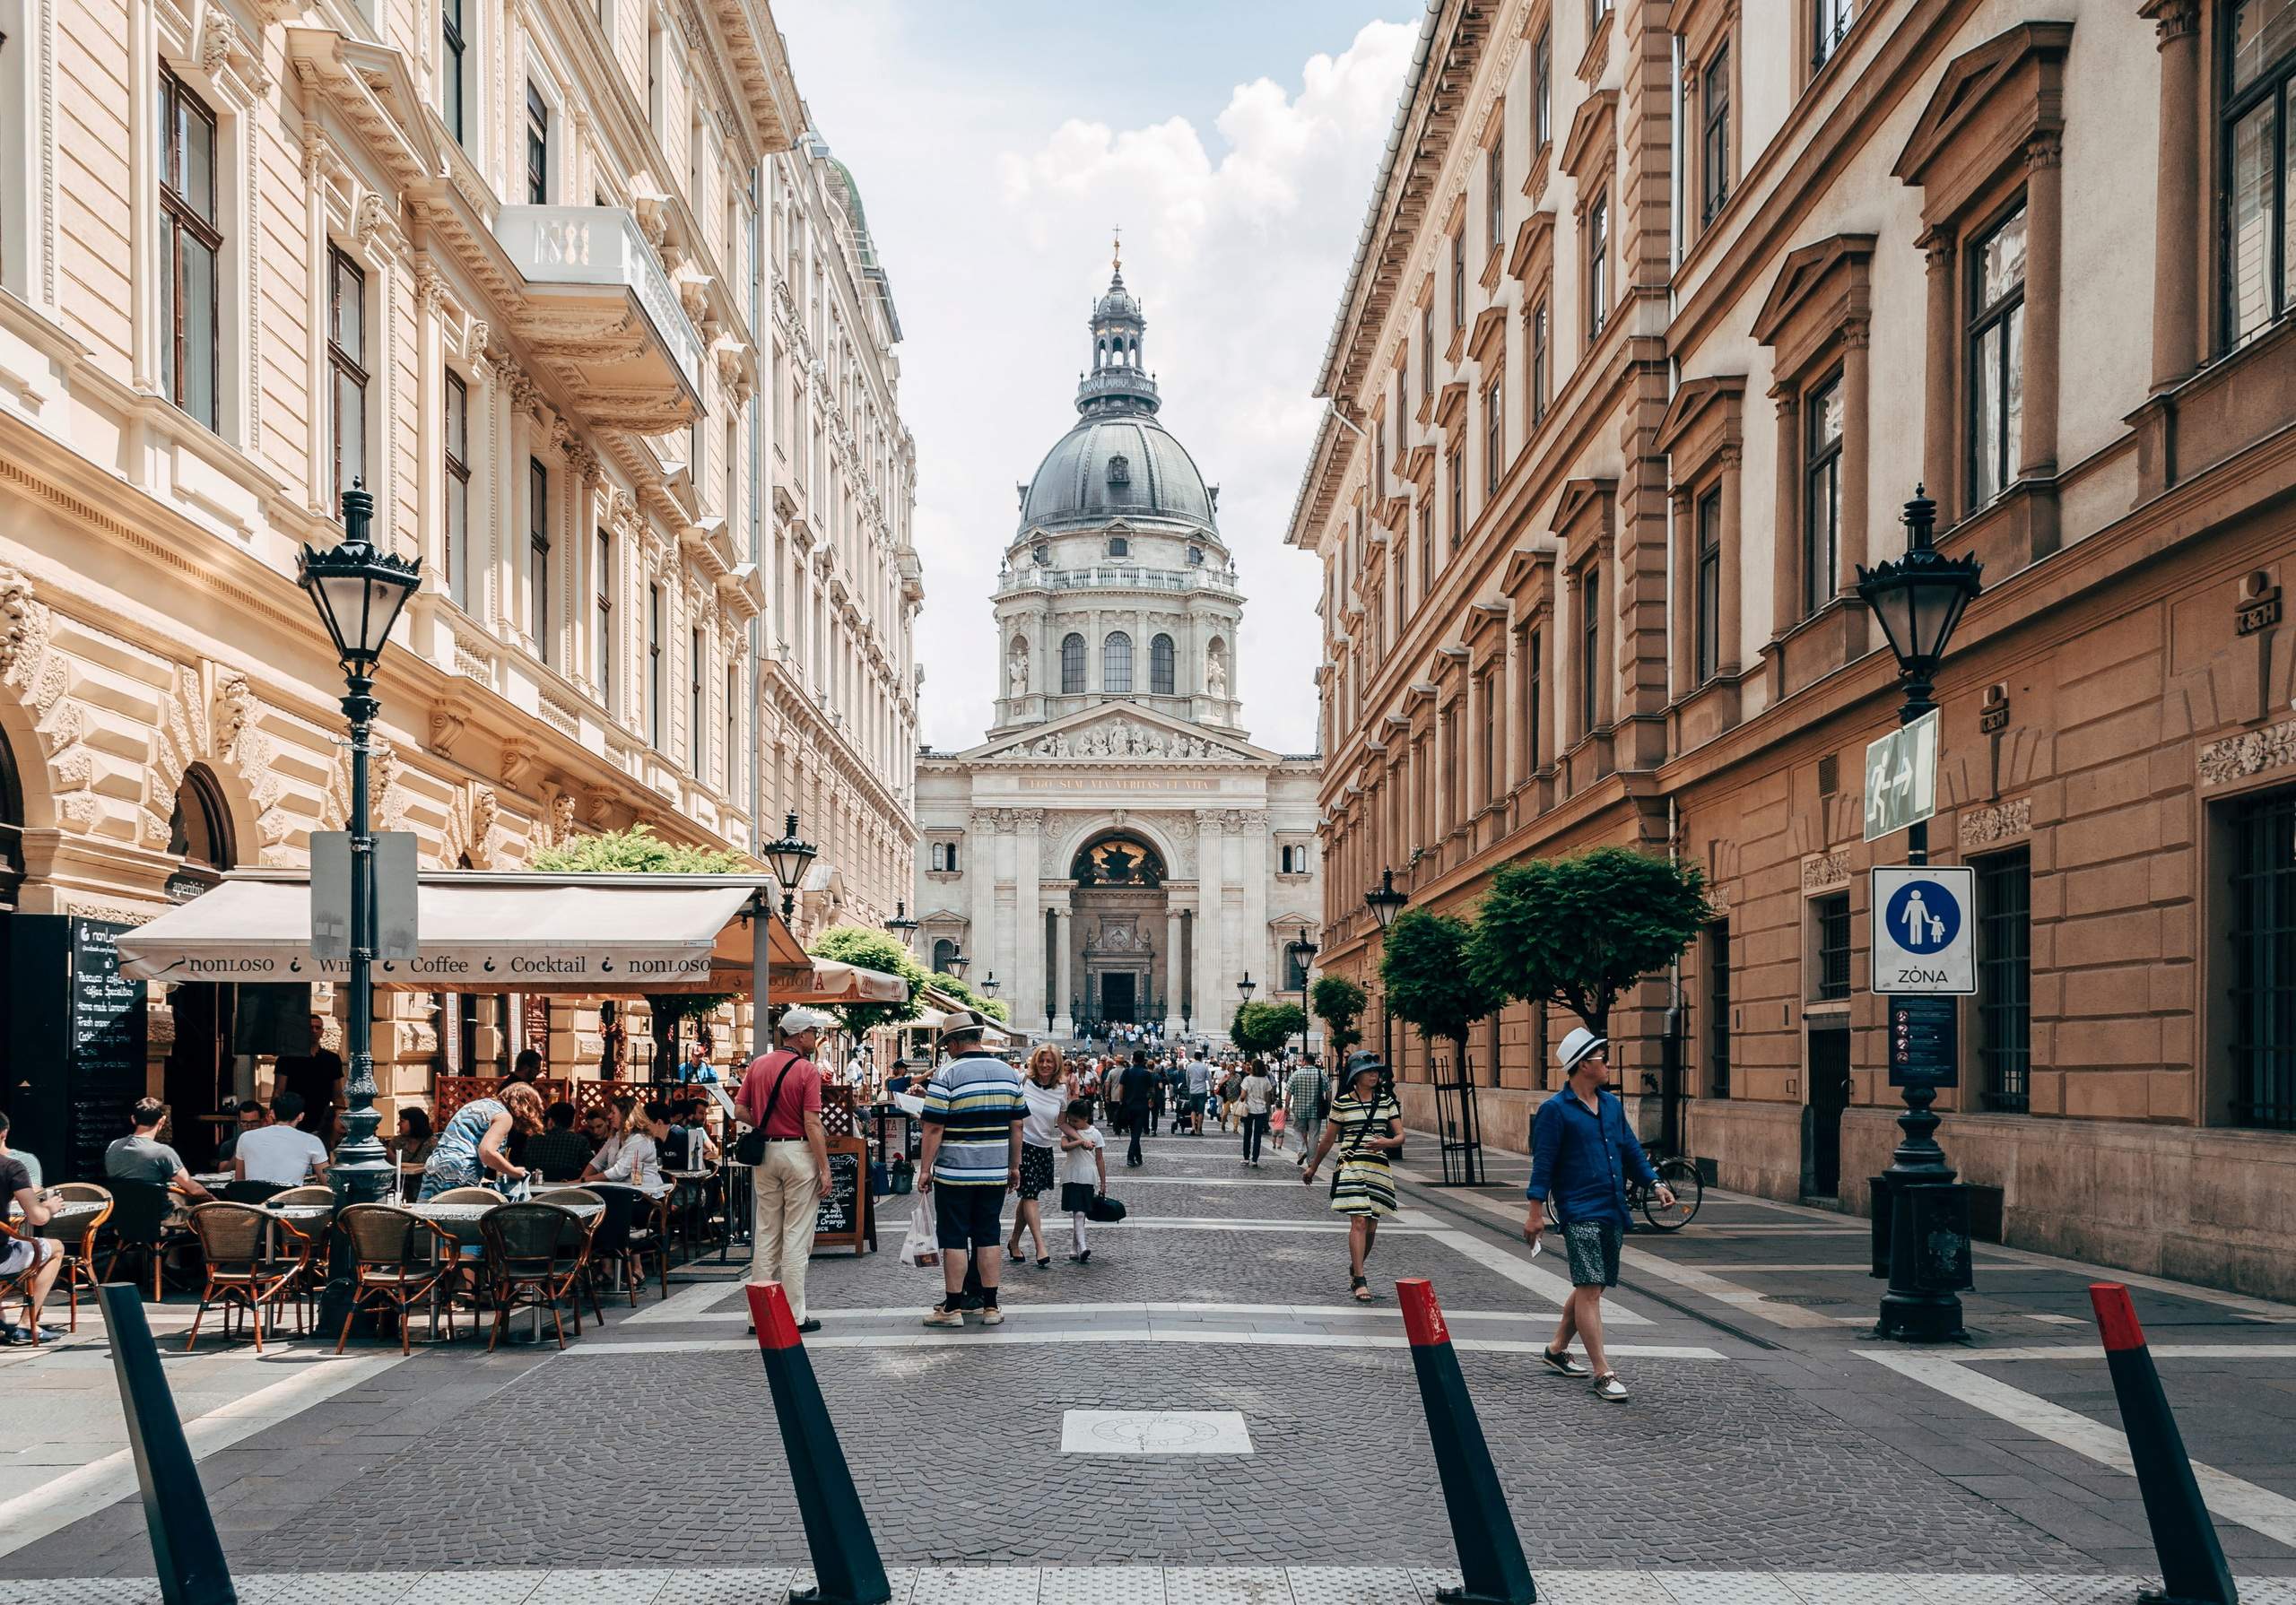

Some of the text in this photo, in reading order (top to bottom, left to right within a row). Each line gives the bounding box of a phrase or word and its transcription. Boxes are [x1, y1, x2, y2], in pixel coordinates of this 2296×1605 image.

[1059, 780, 1083, 789] SUM
[1091, 780, 1110, 789] VIA
[1116, 780, 1161, 789] VERITAS
[1185, 781, 1209, 789] VITA
[92, 927, 118, 943] nonLo
[319, 959, 361, 973] Wi
[410, 956, 469, 973] Coffee
[510, 956, 587, 973] Cocktail
